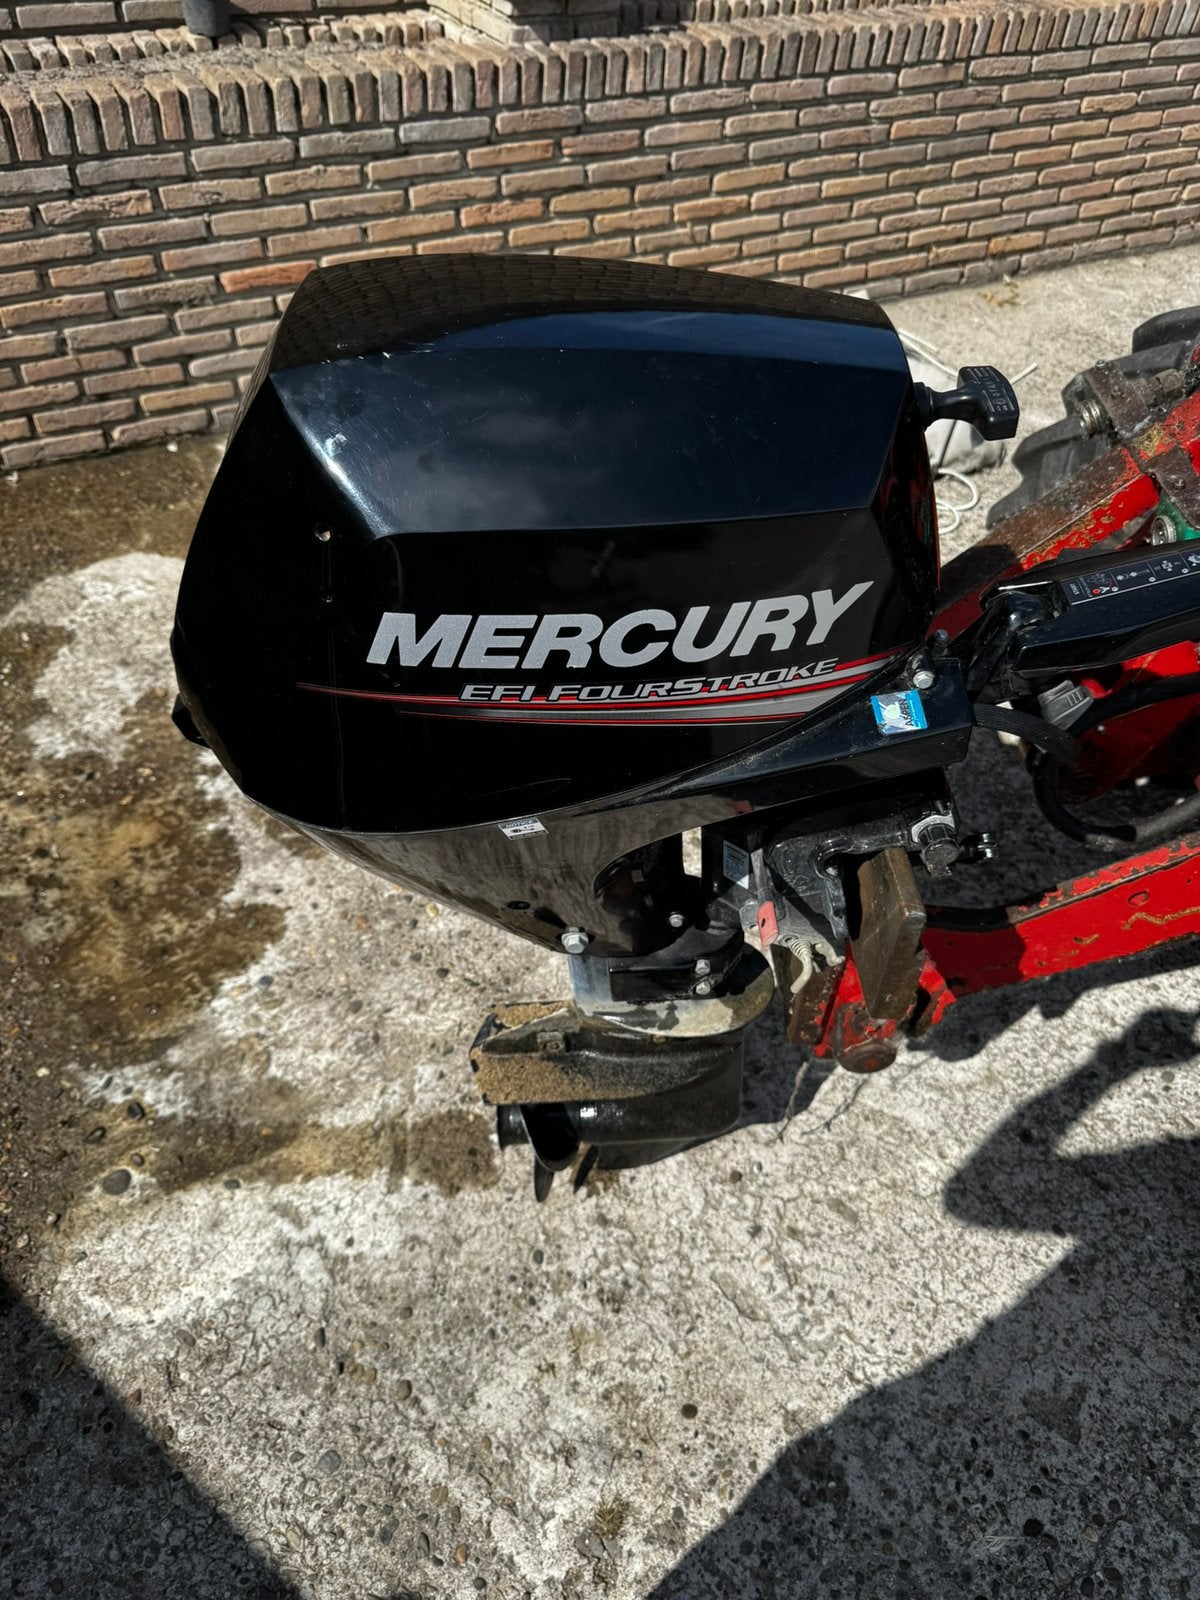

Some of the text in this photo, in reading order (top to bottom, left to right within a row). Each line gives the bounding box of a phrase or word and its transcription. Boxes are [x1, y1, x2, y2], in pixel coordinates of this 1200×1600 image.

[366, 581, 874, 669] MERCURY
[460, 658, 839, 701] EFI FOURSTROKE
[899, 699, 914, 727] ASPEN
